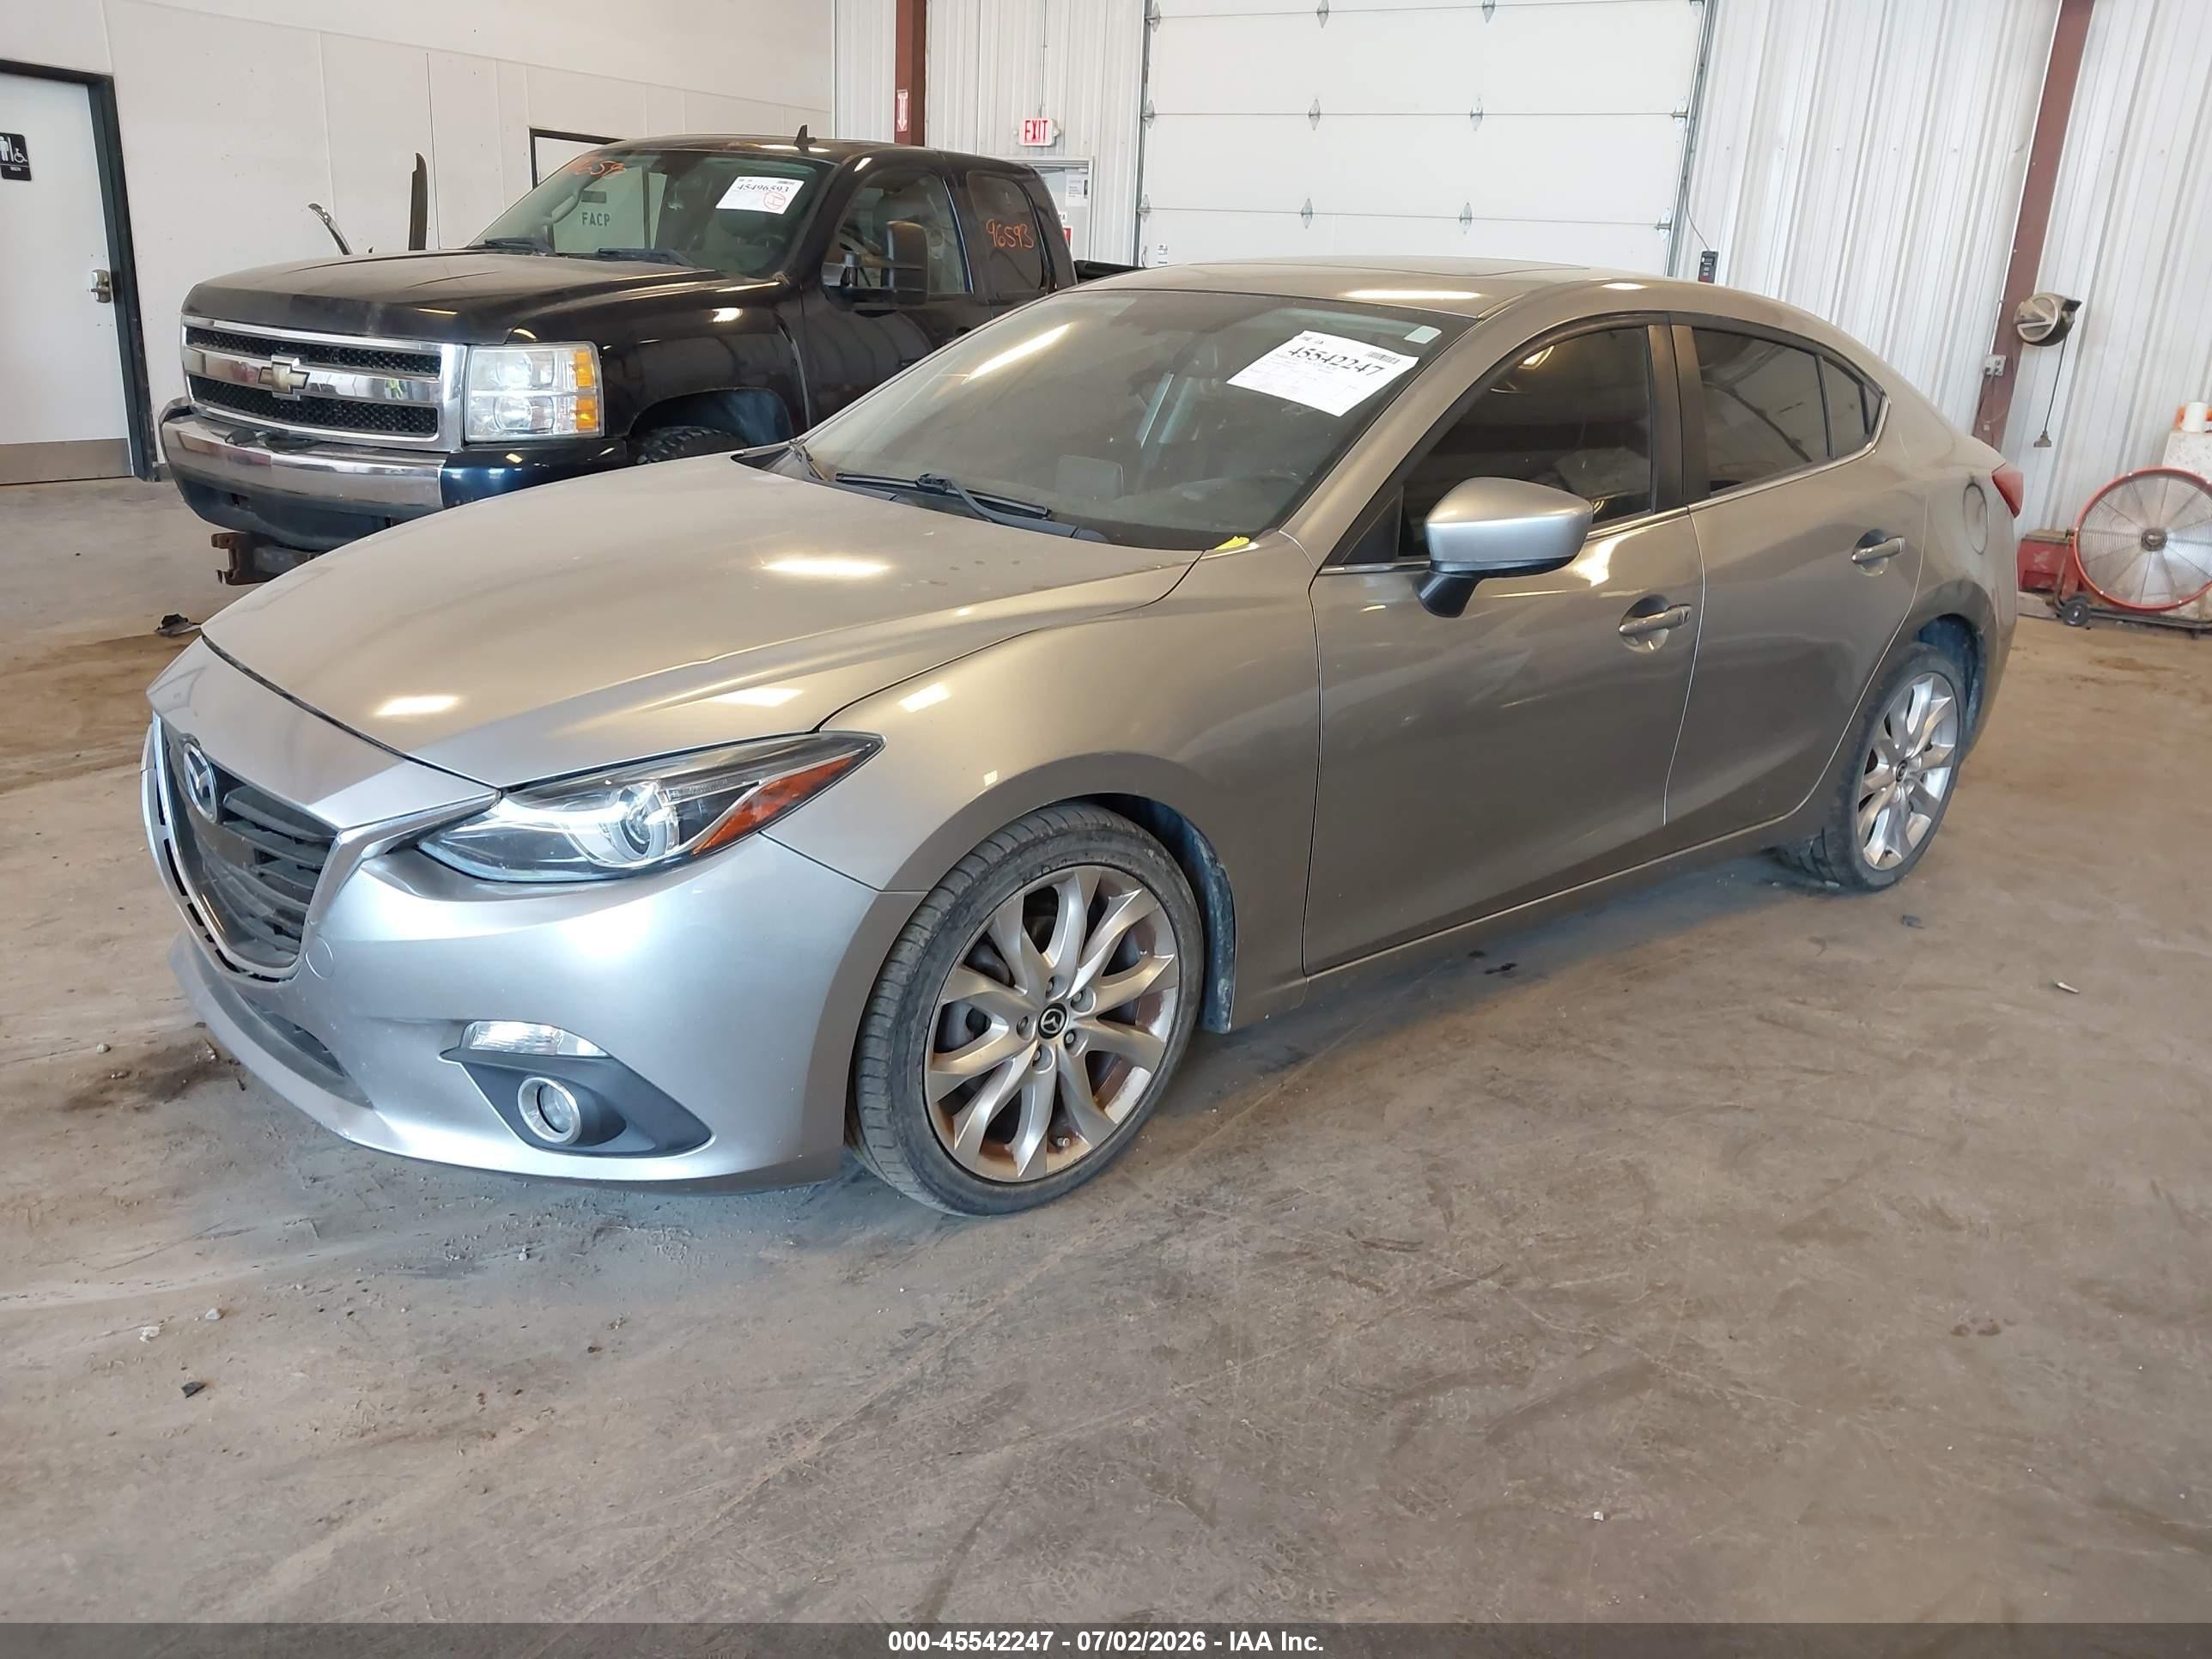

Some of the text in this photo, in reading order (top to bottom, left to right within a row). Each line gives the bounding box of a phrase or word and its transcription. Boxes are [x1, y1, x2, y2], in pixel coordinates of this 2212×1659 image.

[1024, 119, 1048, 143] EXIT
[737, 183, 790, 193] 45496593
[581, 212, 611, 227] FACP
[986, 218, 1035, 248] 96593
[1288, 346, 1386, 376] 45542247
